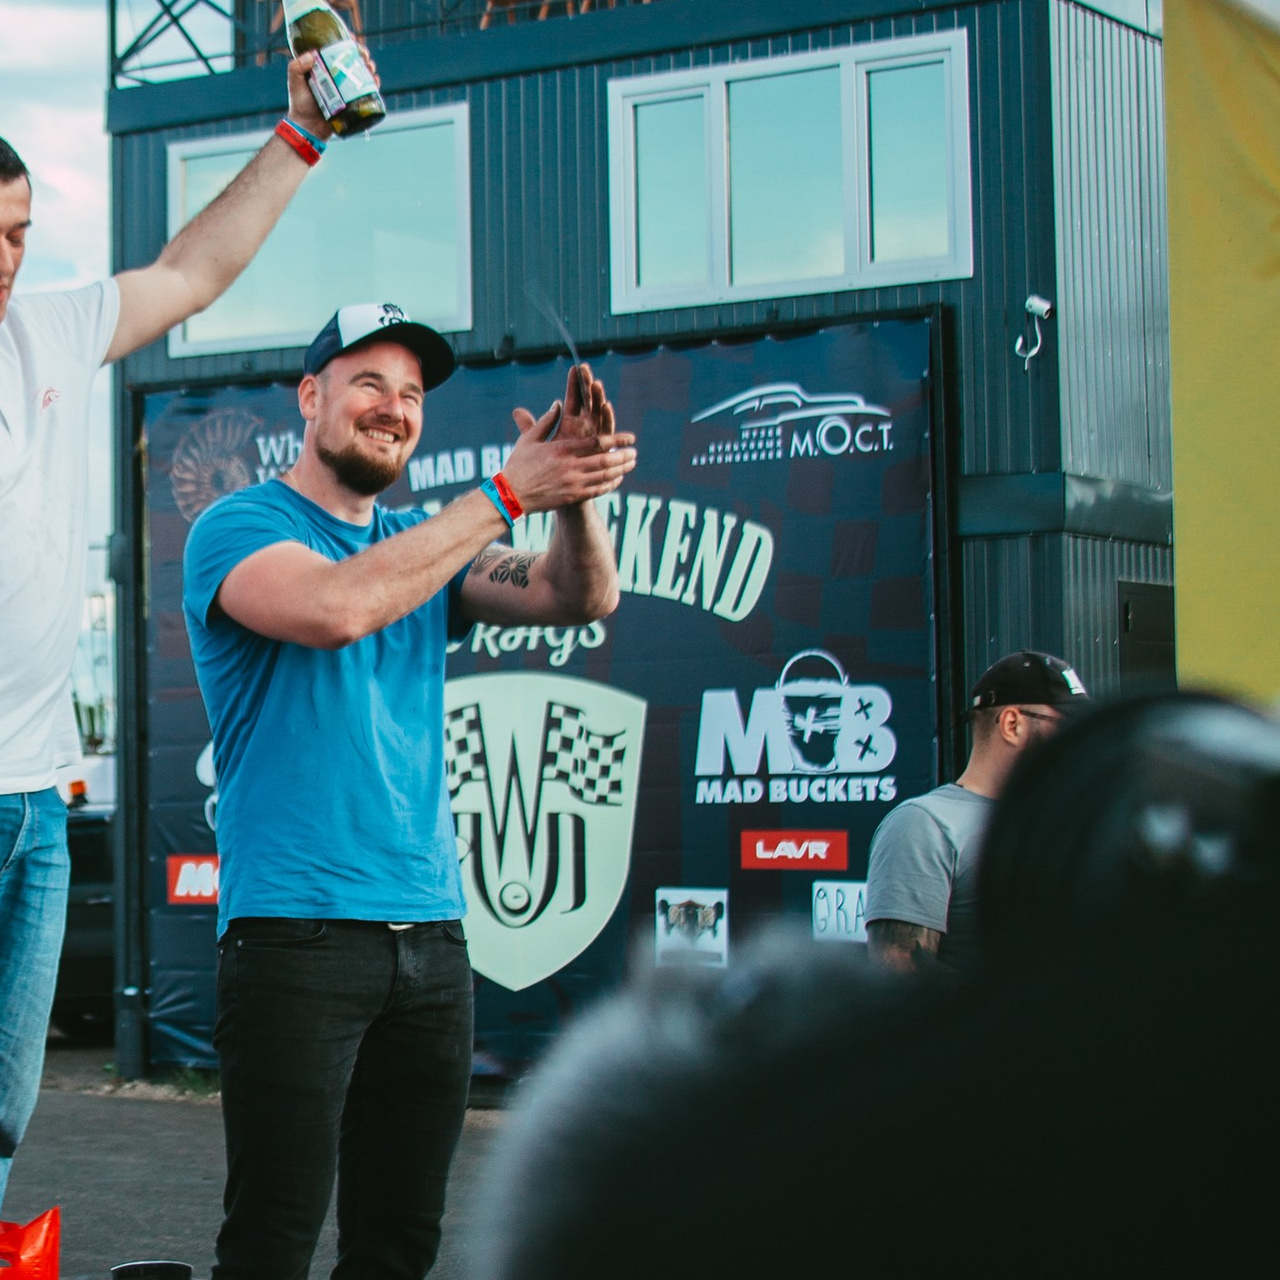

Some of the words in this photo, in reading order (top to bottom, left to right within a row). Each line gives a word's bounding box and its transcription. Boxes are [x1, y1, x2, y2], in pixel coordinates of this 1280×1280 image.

[408, 451, 474, 492] MAD
[695, 778, 764, 804] MAD
[768, 776, 898, 803] BUCKETS
[755, 840, 830, 860] LAVR
